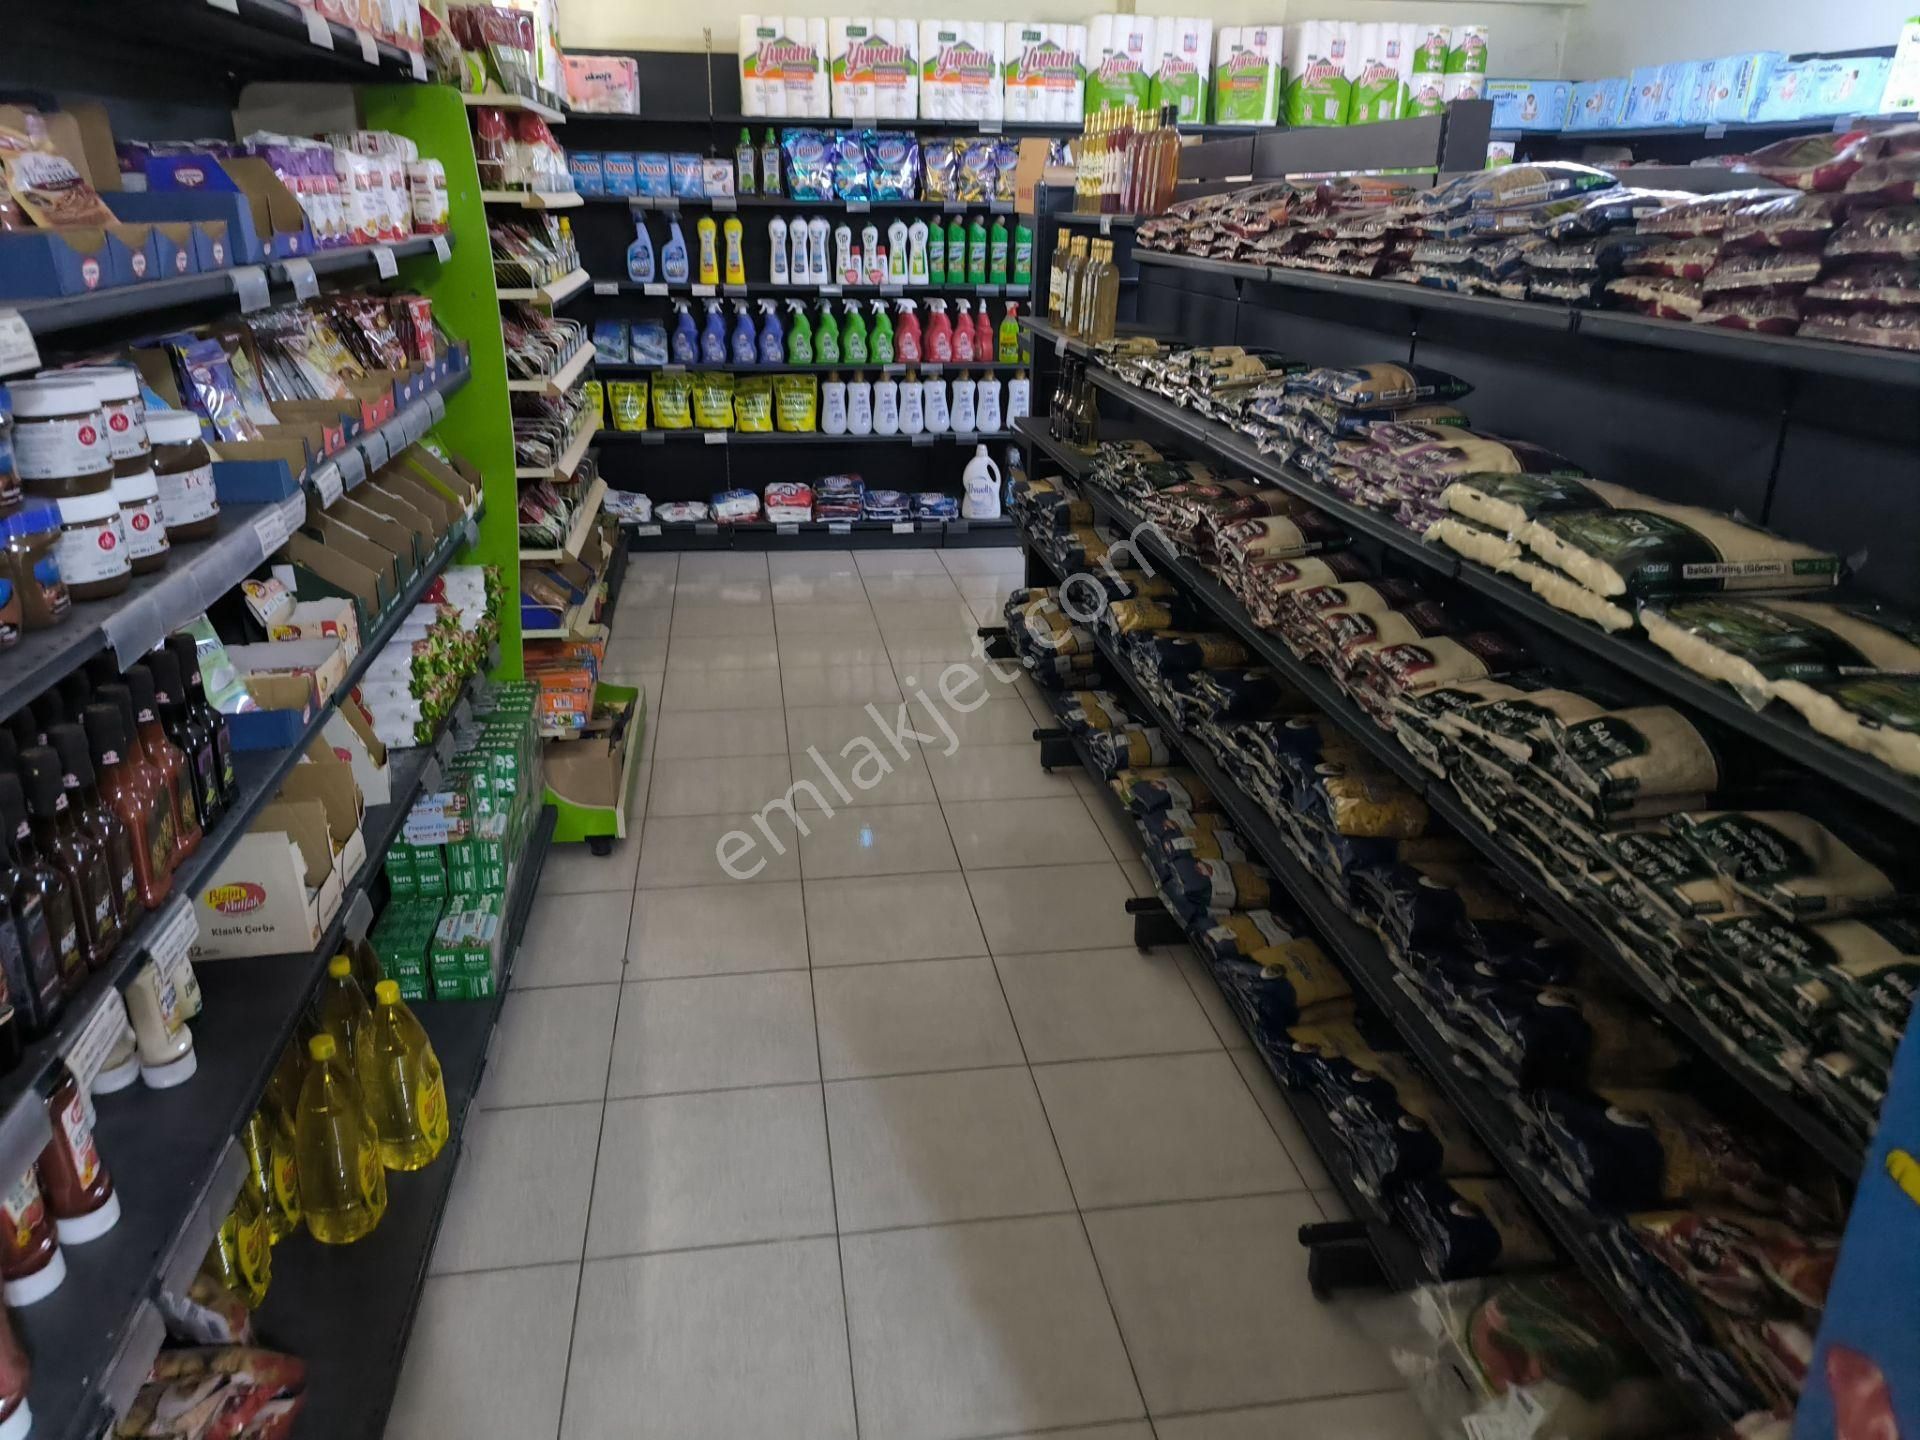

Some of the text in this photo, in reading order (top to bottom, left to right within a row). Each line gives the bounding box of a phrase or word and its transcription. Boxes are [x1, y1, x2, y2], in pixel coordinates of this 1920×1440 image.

[208, 887, 242, 904] Bizim
[224, 895, 260, 913] Mutfak
[211, 926, 243, 937] Klasik
